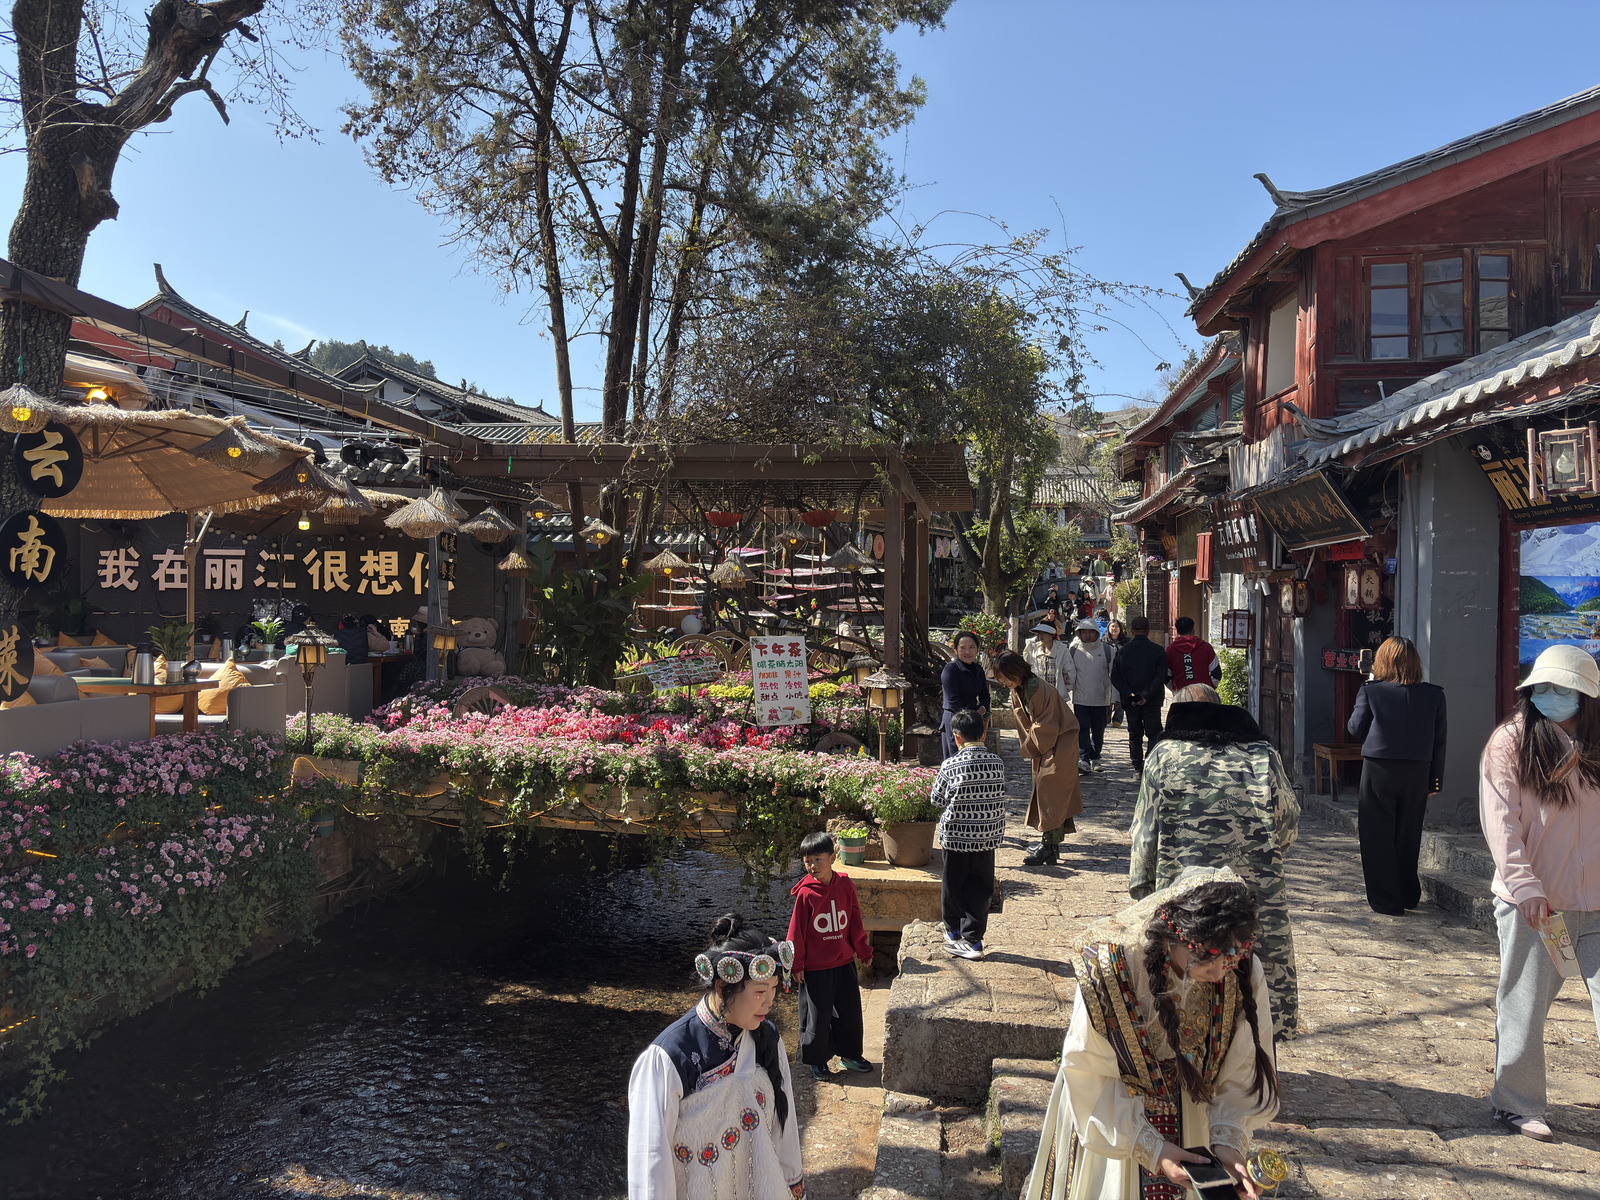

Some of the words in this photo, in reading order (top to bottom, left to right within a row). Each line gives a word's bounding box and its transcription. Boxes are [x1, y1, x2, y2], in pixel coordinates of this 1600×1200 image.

[755, 642, 802, 657] 下午茶
[757, 659, 804, 669] 喝茶晒太阳
[1324, 650, 1360, 670] 营业中
[784, 670, 801, 679] 果汁
[760, 681, 779, 690] 热饮
[785, 680, 803, 690] 冷饮
[760, 692, 779, 701] 甜点
[785, 691, 804, 700] 小吃
